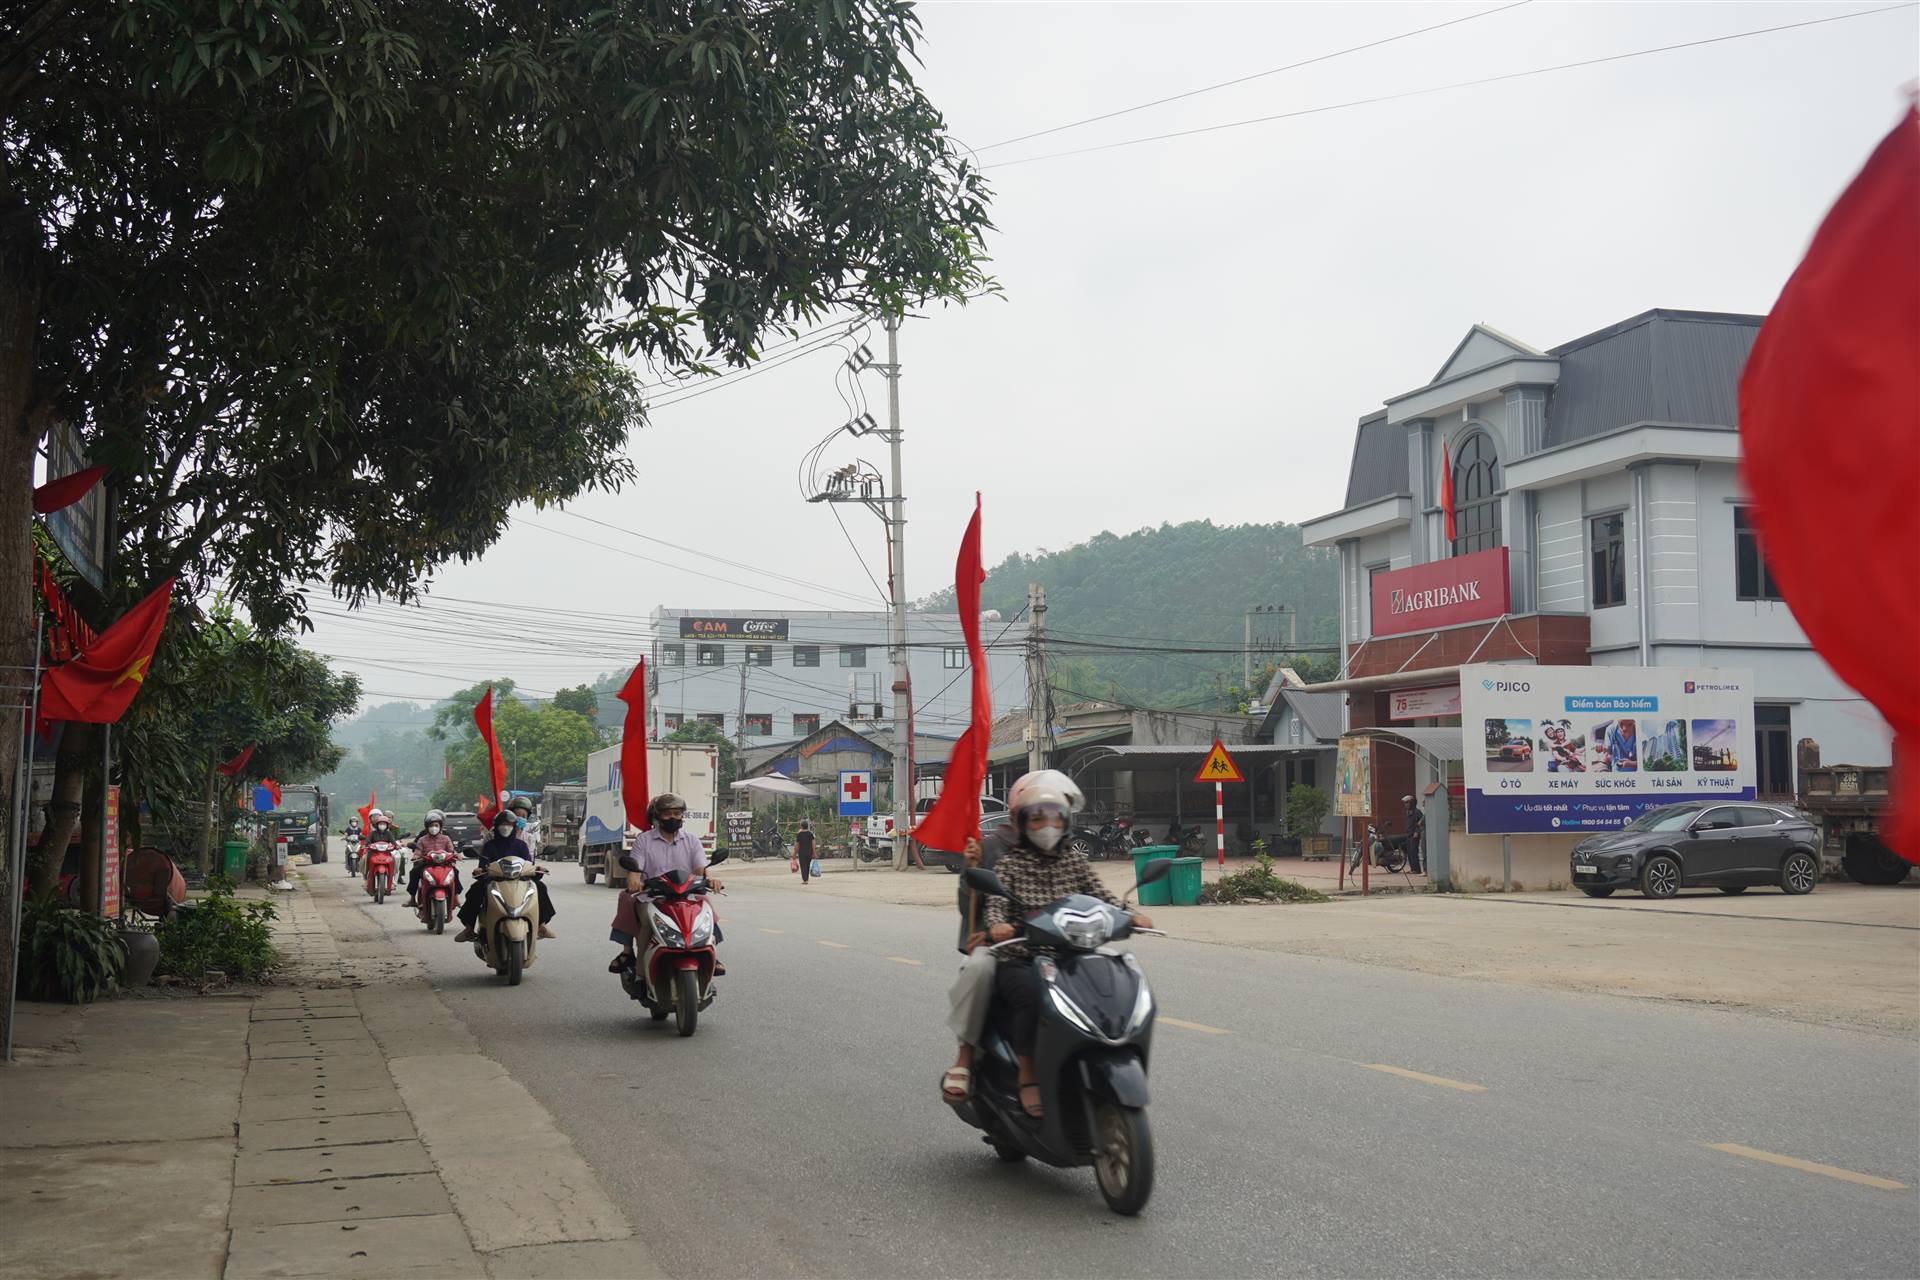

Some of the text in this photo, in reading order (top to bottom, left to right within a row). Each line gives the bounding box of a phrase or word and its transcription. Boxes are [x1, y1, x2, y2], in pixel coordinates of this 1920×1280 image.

[1405, 580, 1481, 612] AGRIBANK
[743, 620, 779, 633] Coffee
[1496, 681, 1531, 692] PJICO
[1396, 698, 1407, 711] 75
[1572, 698, 1594, 709] Điểm
[1595, 698, 1612, 709] bán
[1631, 698, 1652, 709] hiểm
[1501, 778, 1522, 789] Ô TÔ
[1549, 777, 1579, 789] XE MÁY
[1652, 777, 1664, 787] TÀI
[1710, 776, 1735, 789] THUẬT
